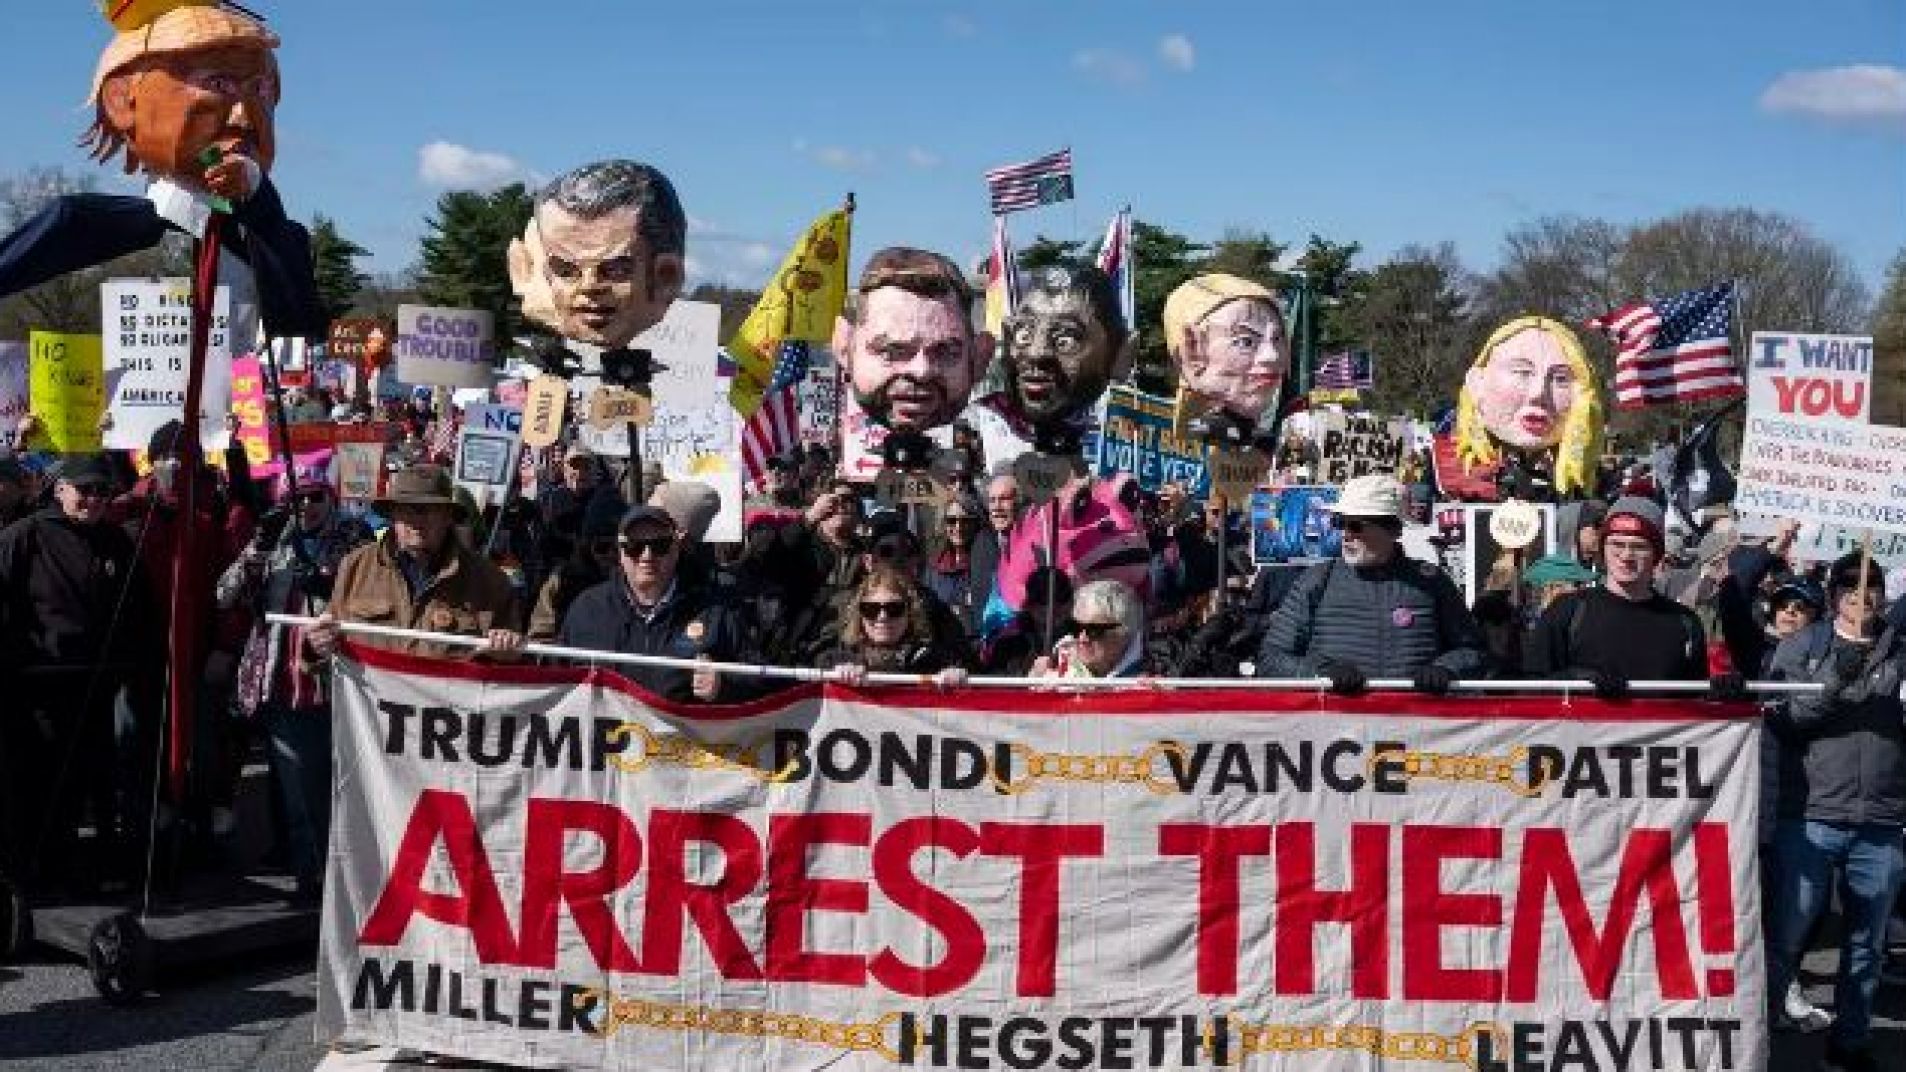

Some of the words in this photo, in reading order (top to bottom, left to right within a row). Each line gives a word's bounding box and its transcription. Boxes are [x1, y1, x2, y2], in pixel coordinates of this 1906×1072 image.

[416, 313, 478, 338] GOOD
[120, 357, 152, 371] THIS
[168, 357, 182, 371] IS
[398, 333, 494, 363] TROUBLE
[1755, 336, 1788, 368] I
[1798, 338, 1872, 373] WANT
[120, 388, 185, 403] AMERICA
[1771, 375, 1864, 418] YOU
[1324, 430, 1403, 466] RACISM
[378, 699, 632, 772] TRUMP
[774, 727, 1014, 790] BONDI
[1164, 739, 1410, 794] VANCE
[1526, 745, 1716, 799] PATEL
[357, 788, 1104, 999] ARREST
[1158, 821, 1736, 1003] THEM!
[351, 957, 600, 1034] MILLER
[898, 1013, 1230, 1069] HEGSETH
[1476, 1018, 1742, 1072] LEAVITT
